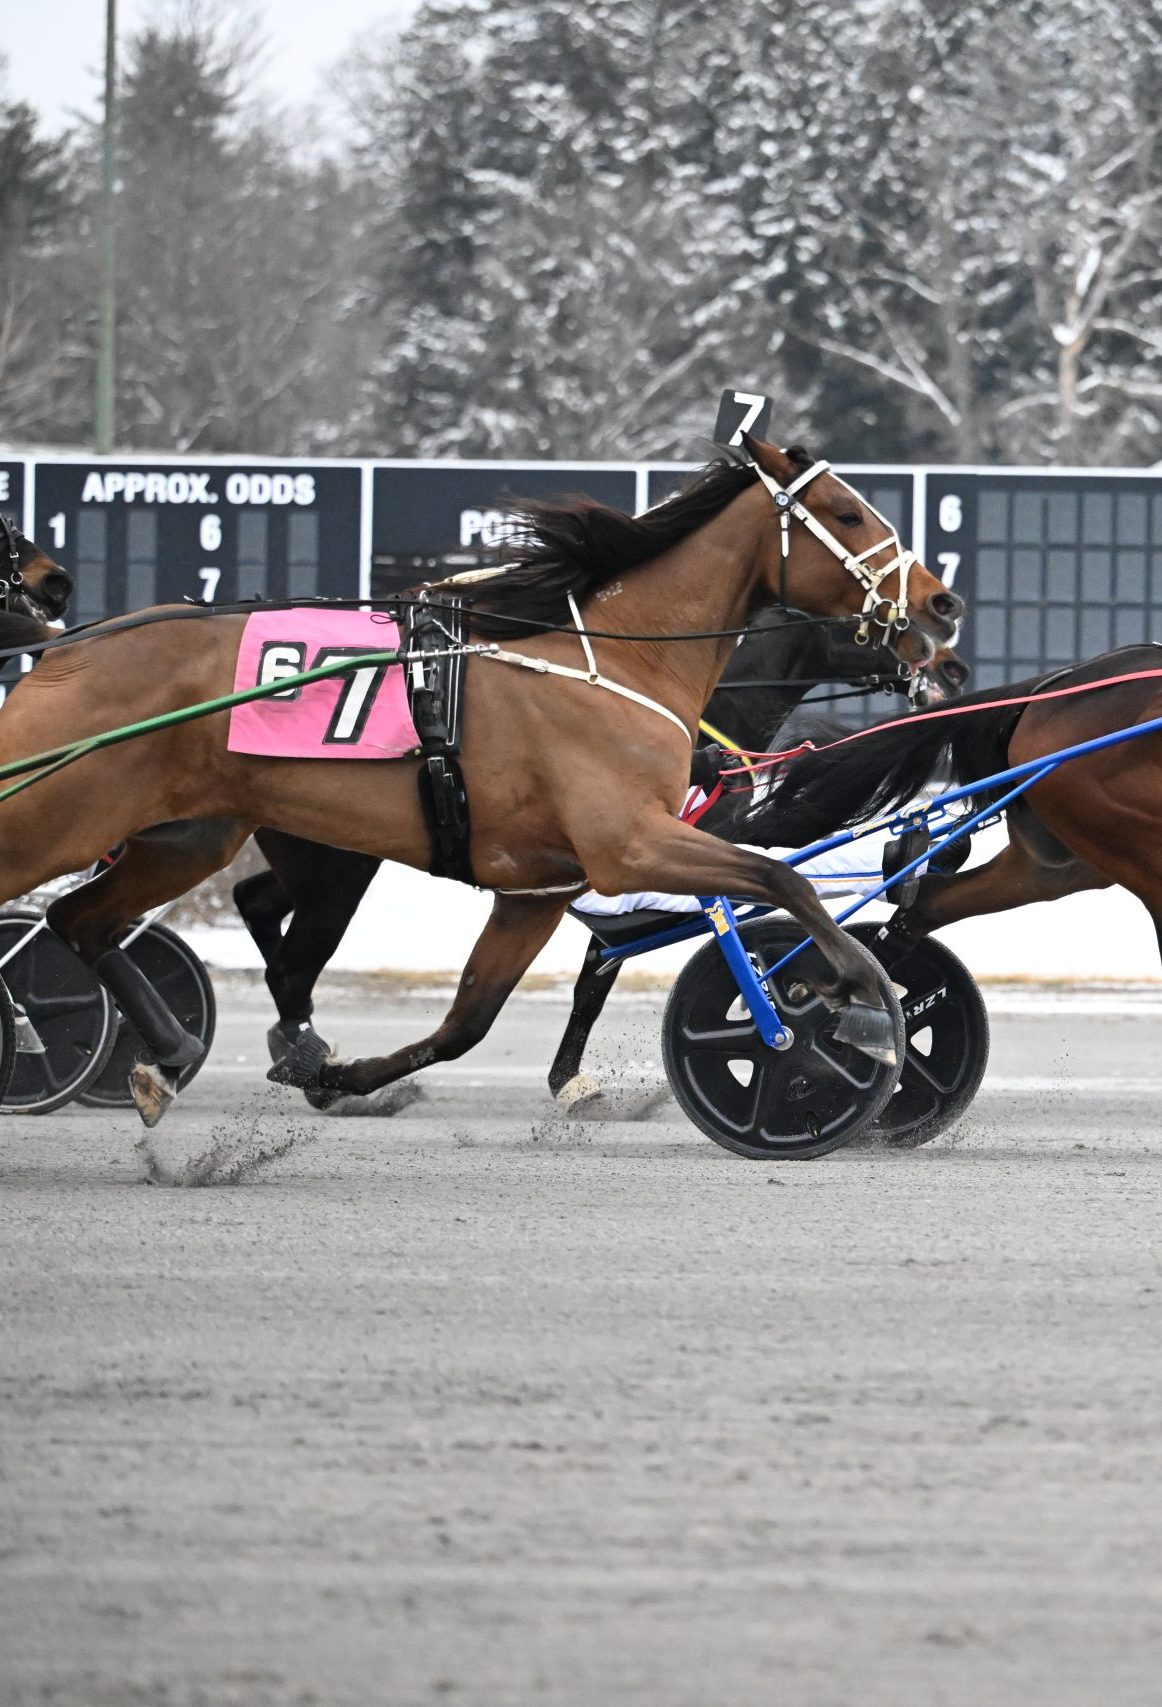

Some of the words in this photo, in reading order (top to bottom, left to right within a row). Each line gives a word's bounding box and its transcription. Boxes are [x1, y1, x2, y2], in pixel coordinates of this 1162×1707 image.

[728, 391, 765, 447] 7
[81, 471, 219, 504] APPROX.
[226, 473, 316, 505] ODDS
[48, 512, 66, 549] 1
[938, 494, 963, 532] 6
[200, 514, 222, 551] 6
[199, 567, 221, 603] 7
[937, 552, 961, 589] 7
[260, 645, 302, 699] 6
[314, 650, 390, 741] 7
